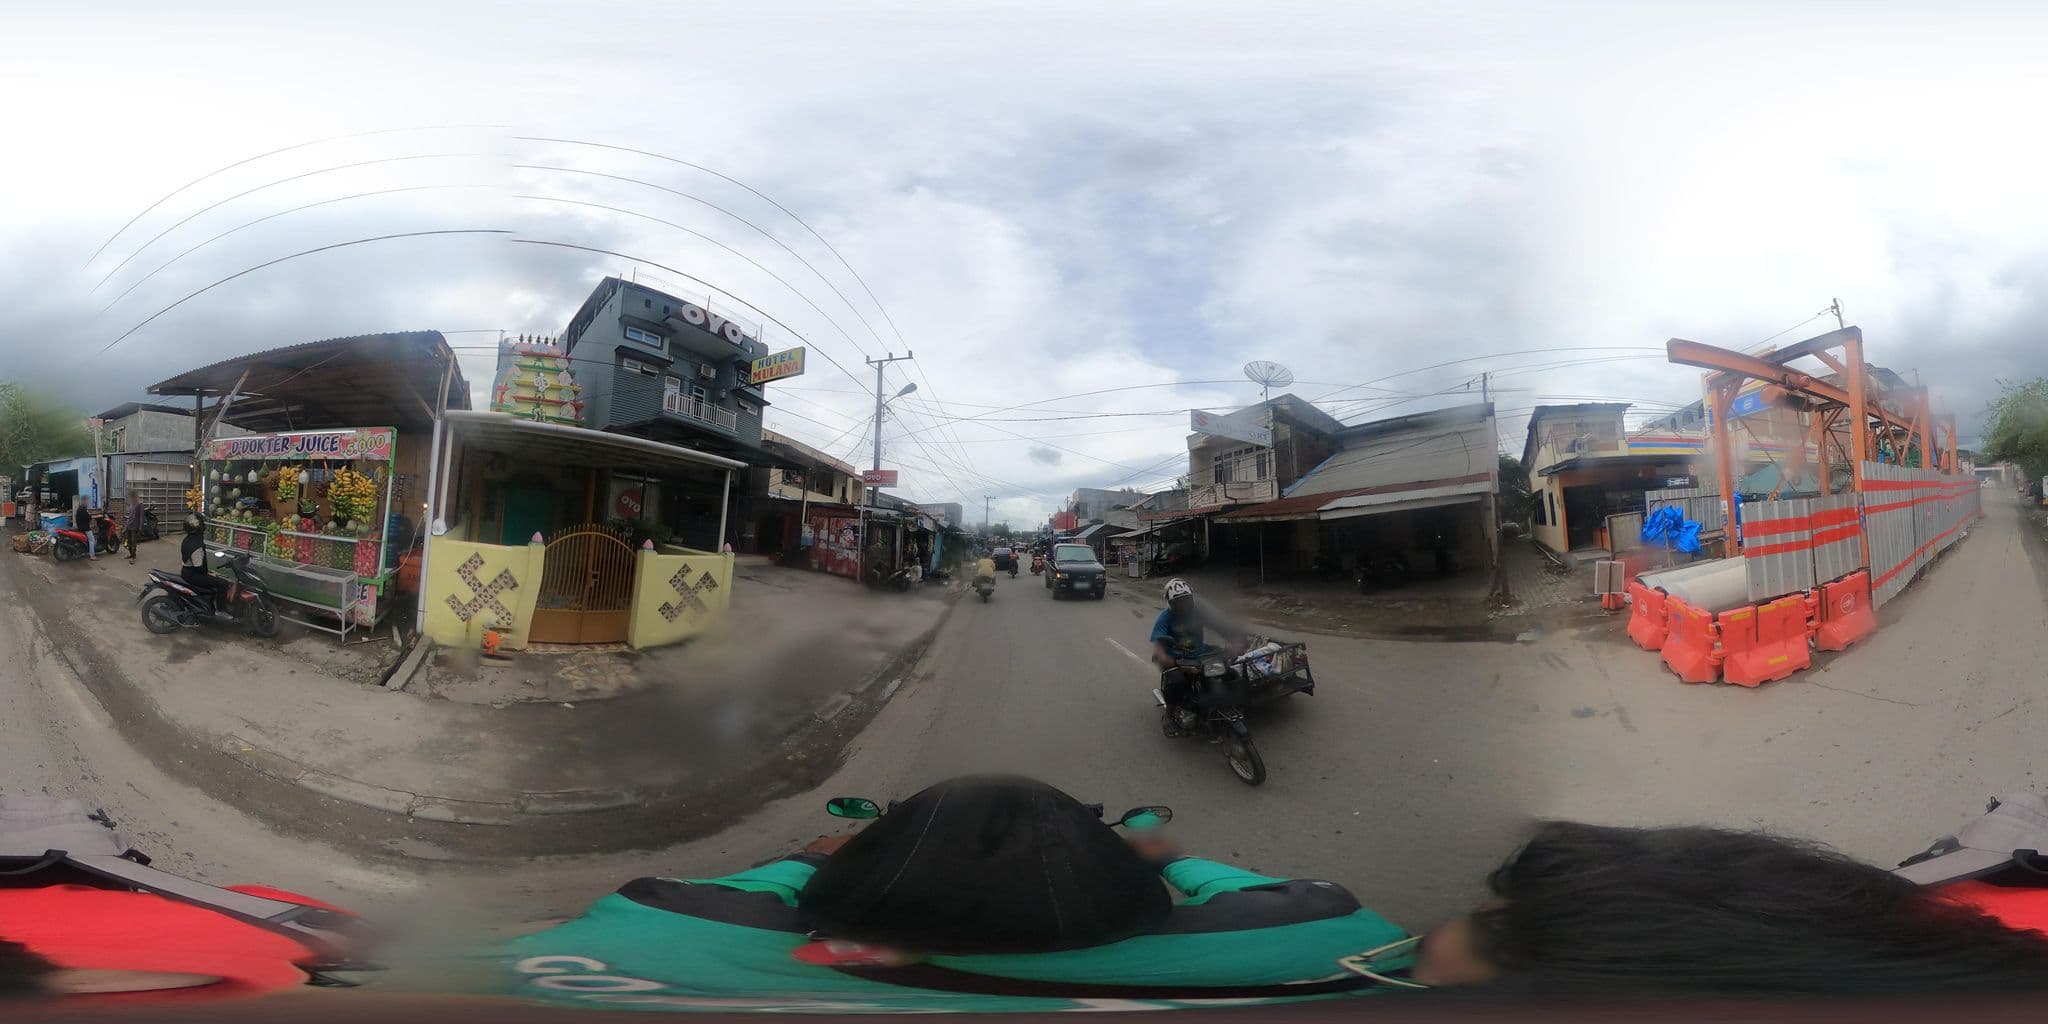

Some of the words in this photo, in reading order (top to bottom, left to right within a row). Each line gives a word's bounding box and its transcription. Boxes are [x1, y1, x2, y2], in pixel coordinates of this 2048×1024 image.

[681, 303, 743, 345] OYO
[758, 352, 794, 369] HOTEL
[295, 435, 340, 452] JUICE
[621, 495, 640, 512] OYO
